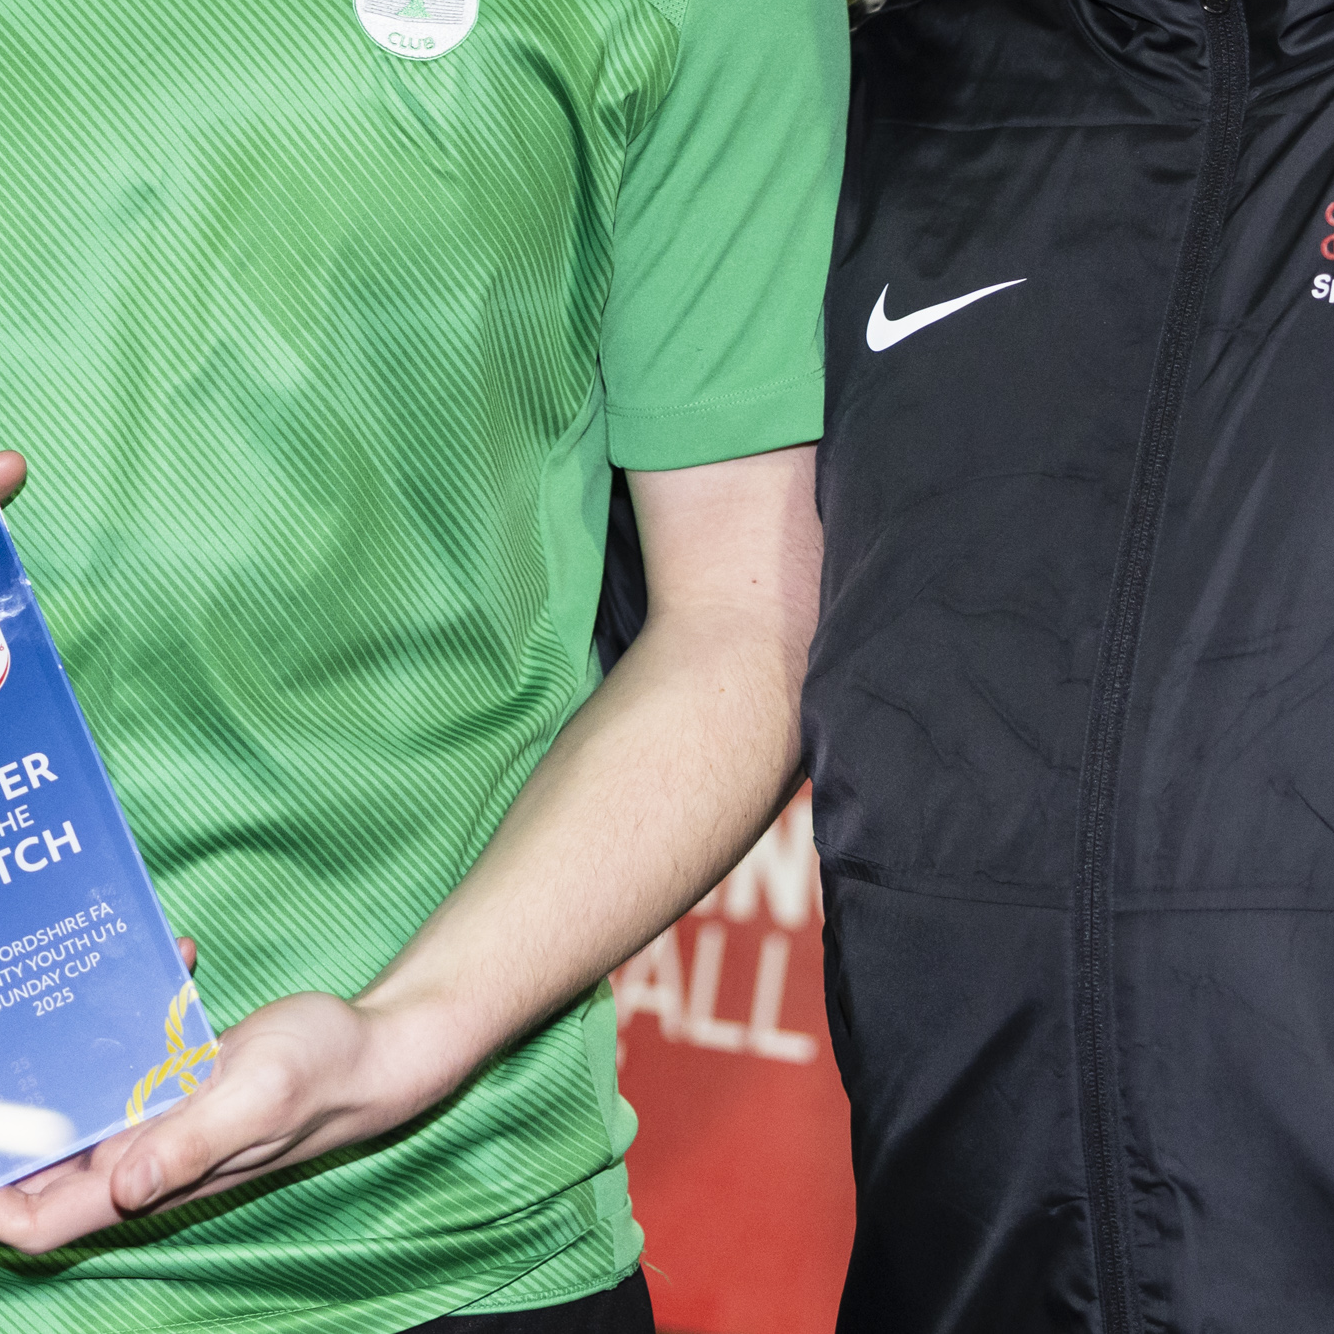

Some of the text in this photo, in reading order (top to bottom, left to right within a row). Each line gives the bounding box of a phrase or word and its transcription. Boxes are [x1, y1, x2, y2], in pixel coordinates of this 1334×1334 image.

[387, 32, 436, 50] CLUB
[89, 902, 114, 922] FA
[25, 933, 91, 972] YOUTH
[92, 918, 127, 943] U16
[64, 952, 100, 978] CUP
[32, 987, 75, 1016] 2025
